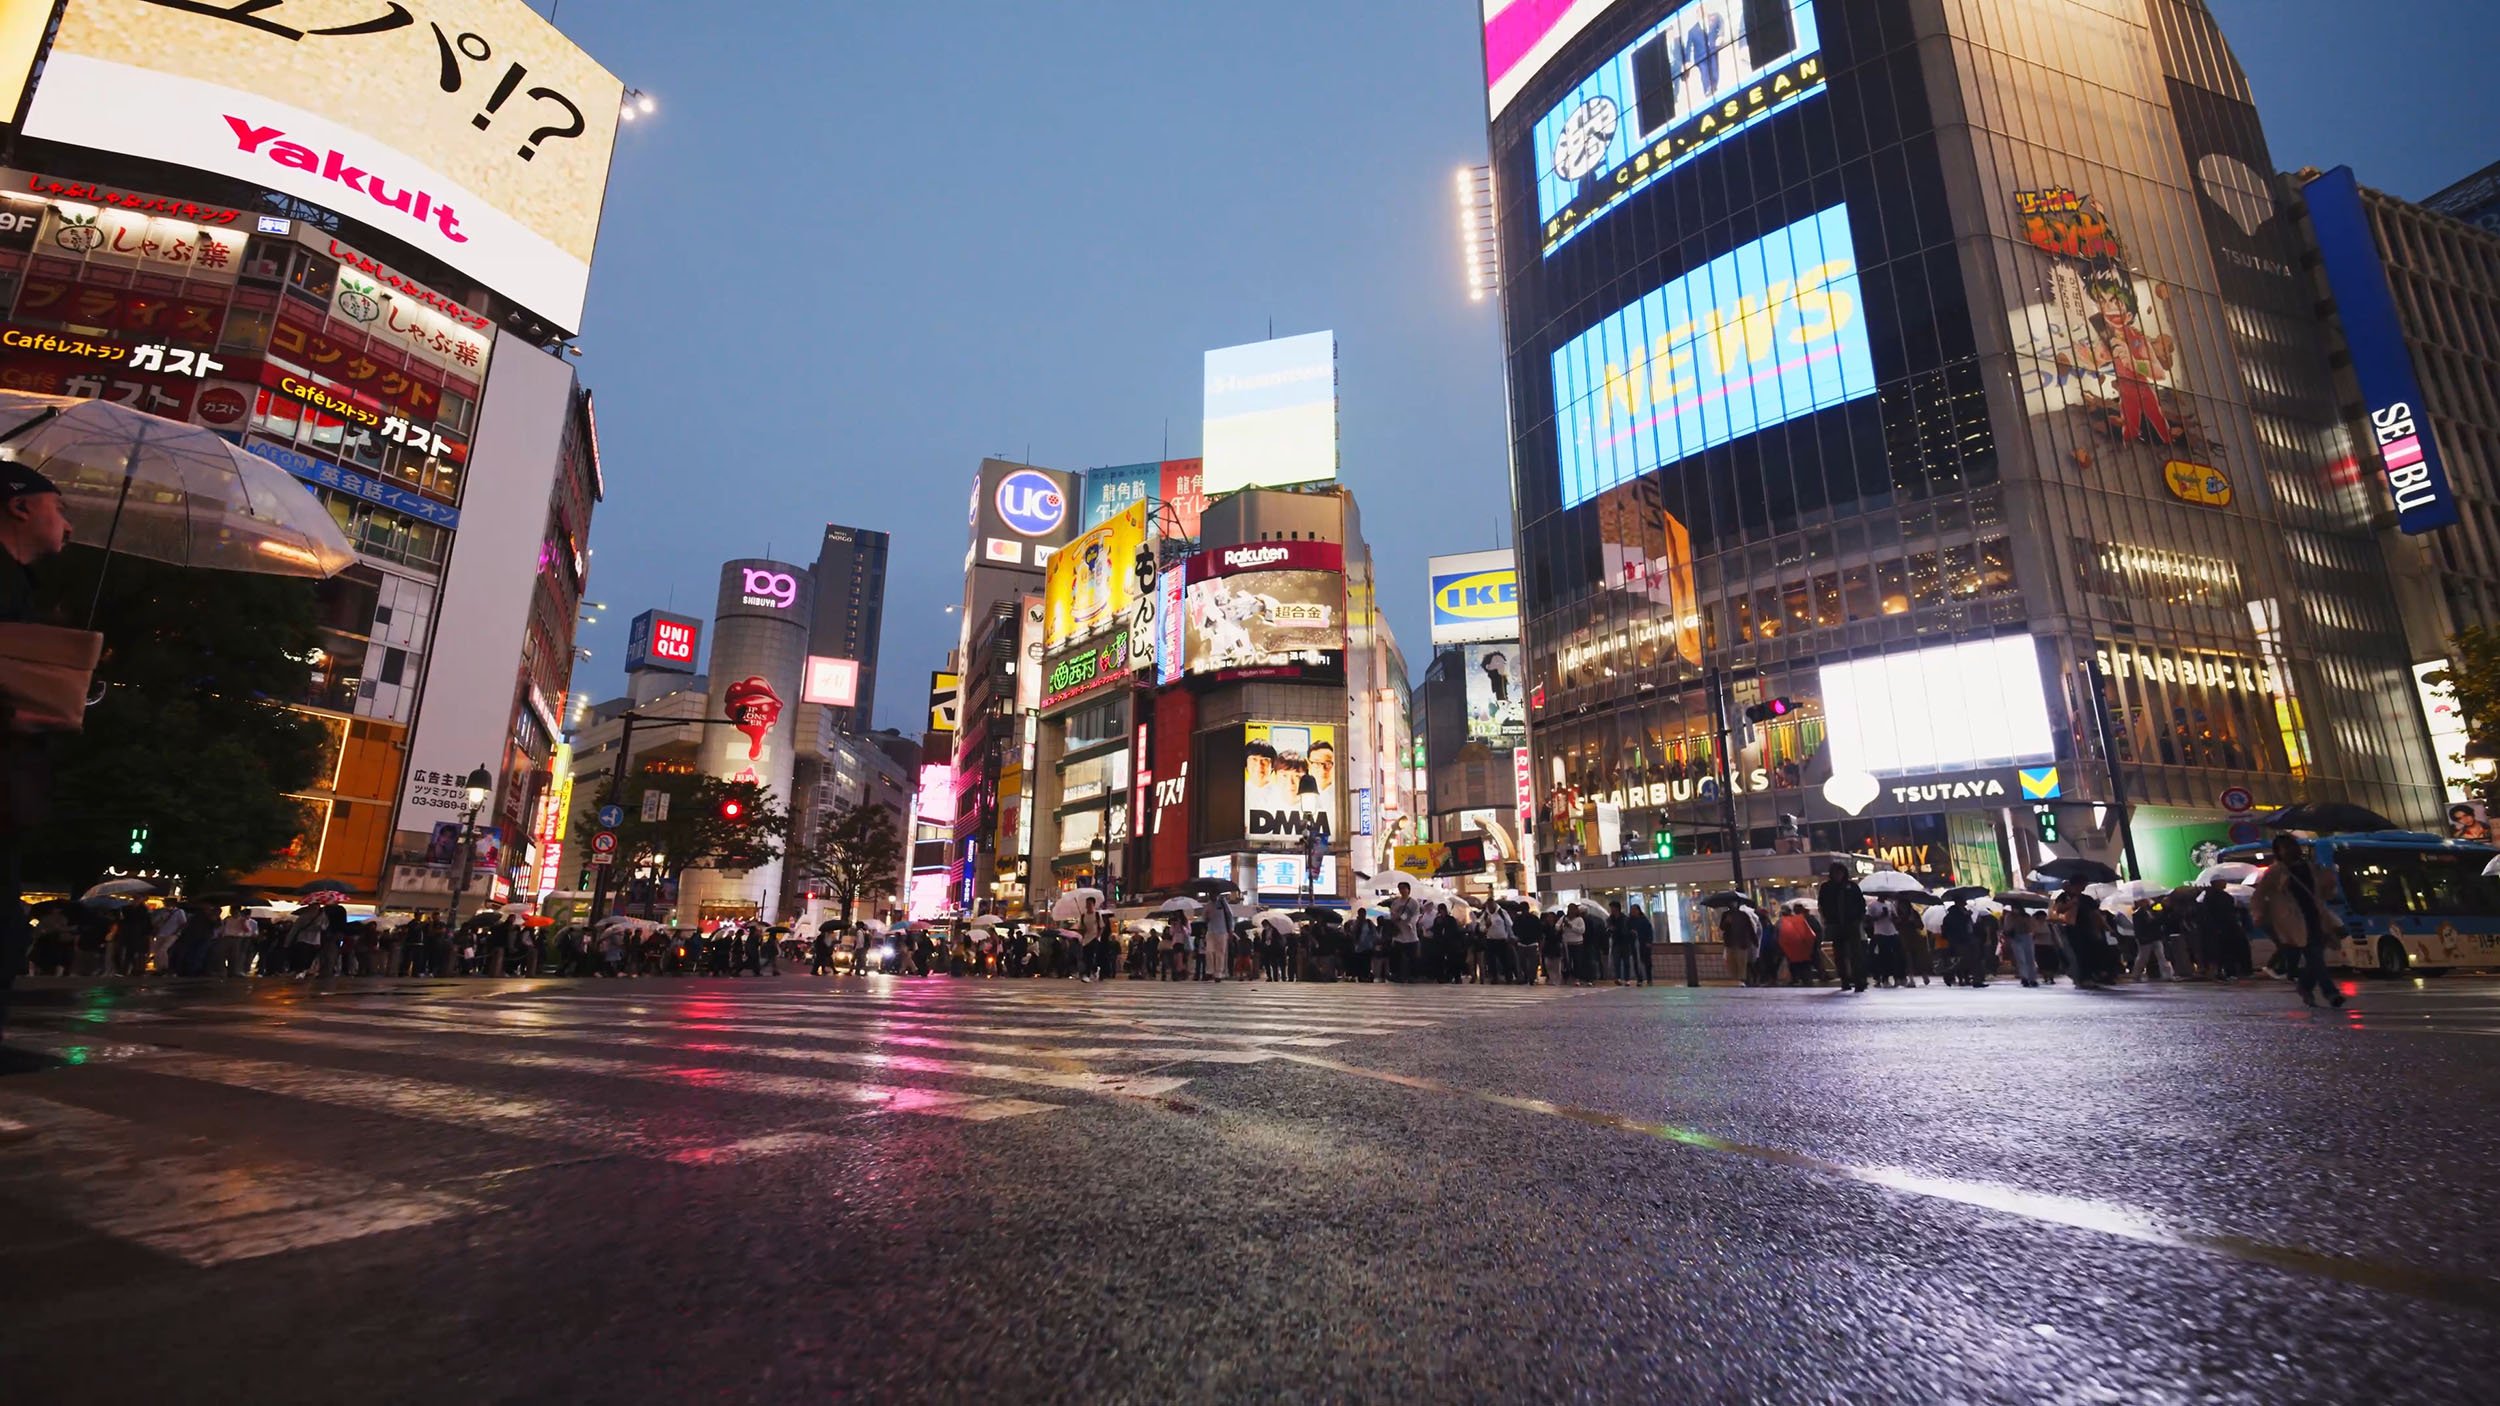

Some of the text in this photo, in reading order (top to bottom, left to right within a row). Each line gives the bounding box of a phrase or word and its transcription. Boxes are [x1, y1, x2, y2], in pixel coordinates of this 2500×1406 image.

[222, 114, 469, 243] Yakult
[28, 174, 241, 225] しゃぶしゃぶバイキング
[112, 226, 231, 269] しゃぶ葉
[2222, 247, 2293, 277] TSUTAYA
[329, 239, 489, 330] しゃぶしゃぶバイキング
[388, 304, 481, 368] しゃぶ葉
[1602, 259, 1853, 427] NEWS
[129, 344, 224, 378] ガスト
[272, 322, 434, 408] コンタクト
[63, 375, 181, 414] ガスト
[203, 402, 241, 415] ガスト
[382, 414, 453, 459] ガスト
[319, 464, 457, 523] 英会話イーオン
[1176, 474, 1203, 496] 龍角
[1004, 484, 1059, 521] UC
[1224, 546, 1289, 567] Rakuten
[742, 596, 776, 608] SHIBUYA
[743, 568, 796, 608] 109
[1132, 543, 1157, 663] もんじゃ
[1447, 583, 1518, 608] IKE
[1275, 605, 1321, 619] 超合金
[657, 639, 690, 658] QLO
[660, 624, 689, 643] UNI
[2096, 649, 2272, 694] STARBUCKS
[743, 712, 767, 721] ONS
[413, 769, 467, 788] 広告主募
[1892, 779, 2005, 804] TSUTAYA
[411, 796, 485, 813] 03-3369-81
[1249, 808, 1331, 836] DMM
